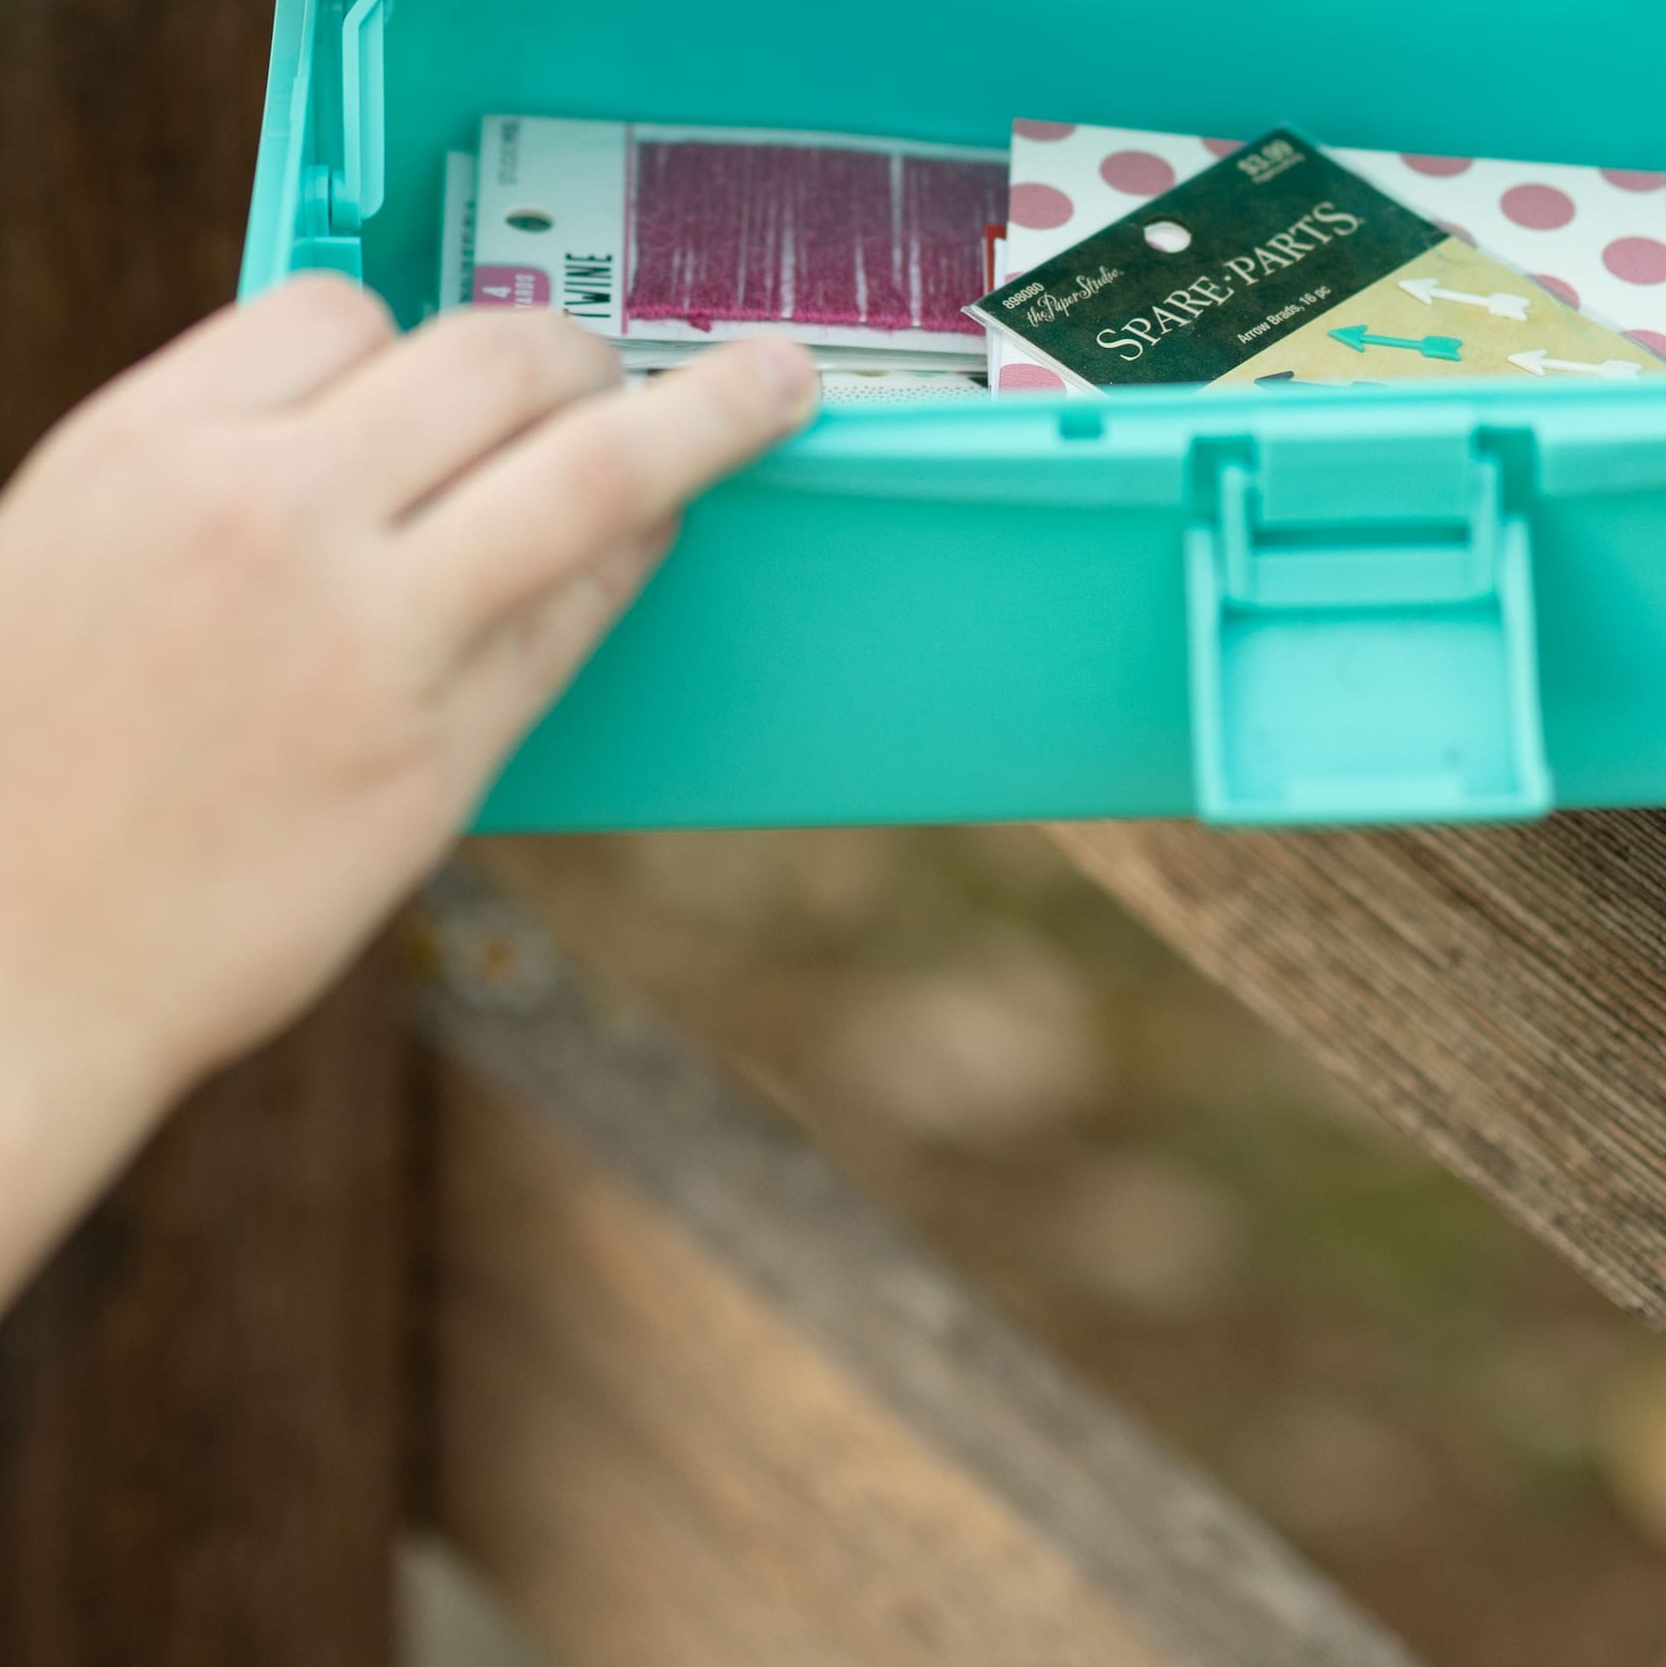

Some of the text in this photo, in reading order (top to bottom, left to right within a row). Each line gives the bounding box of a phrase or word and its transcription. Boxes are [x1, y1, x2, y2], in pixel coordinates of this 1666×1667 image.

[482, 285, 512, 298] 4
[563, 252, 613, 319] TWINE
[1002, 283, 1045, 310] 898080
[1237, 285, 1332, 344] Arrow Brads, 16 pc
